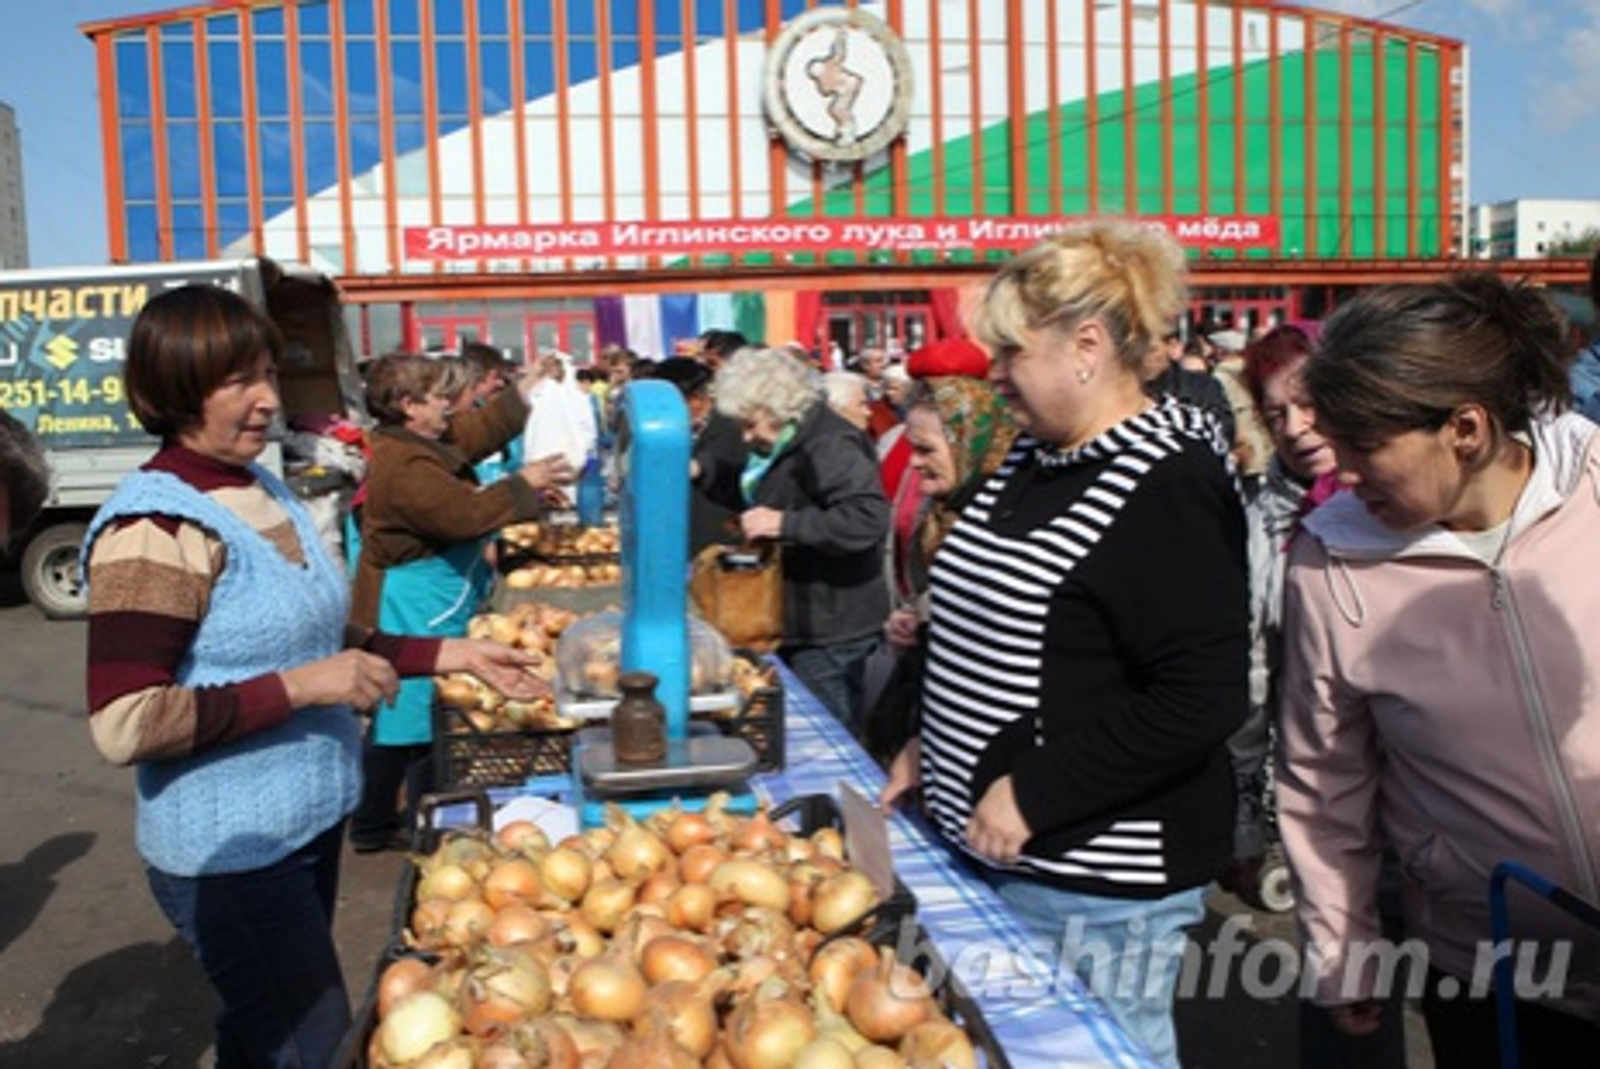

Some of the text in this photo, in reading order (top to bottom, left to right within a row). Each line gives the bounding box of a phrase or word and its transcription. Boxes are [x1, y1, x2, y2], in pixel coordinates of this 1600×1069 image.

[427, 227, 600, 255] Ярмарка
[612, 223, 832, 247] Иглинского
[840, 221, 925, 246] лука
[936, 222, 958, 240] и
[1178, 216, 1261, 241] мёда
[0, 283, 148, 323] пчасти
